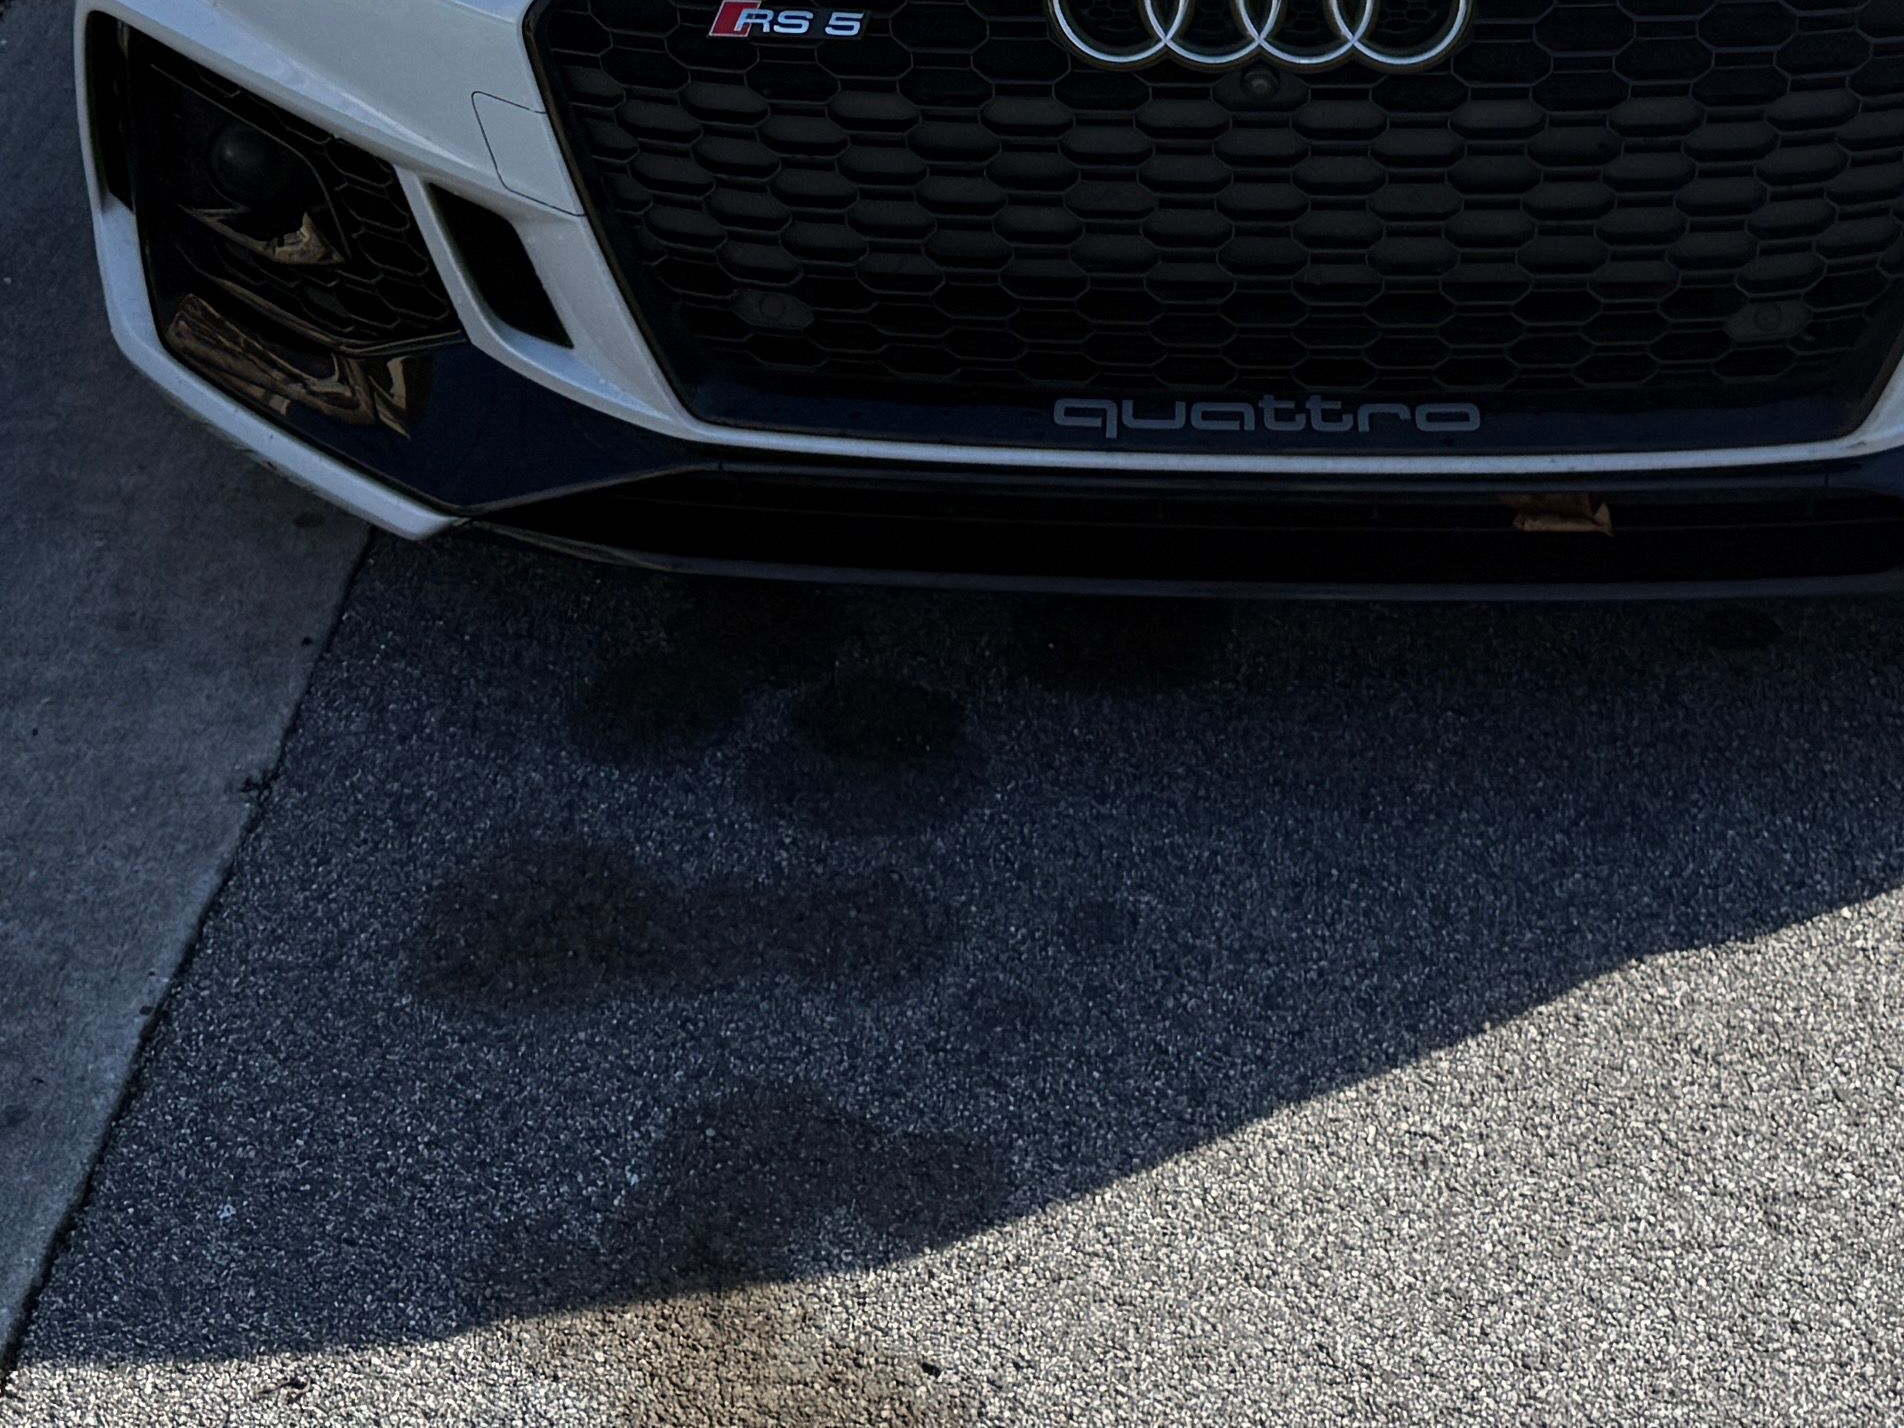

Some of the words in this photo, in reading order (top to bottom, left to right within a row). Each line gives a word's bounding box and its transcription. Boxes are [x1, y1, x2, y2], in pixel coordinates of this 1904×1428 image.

[733, 8, 814, 35] RS
[824, 12, 865, 36] 5
[1053, 394, 1481, 439] quattro
